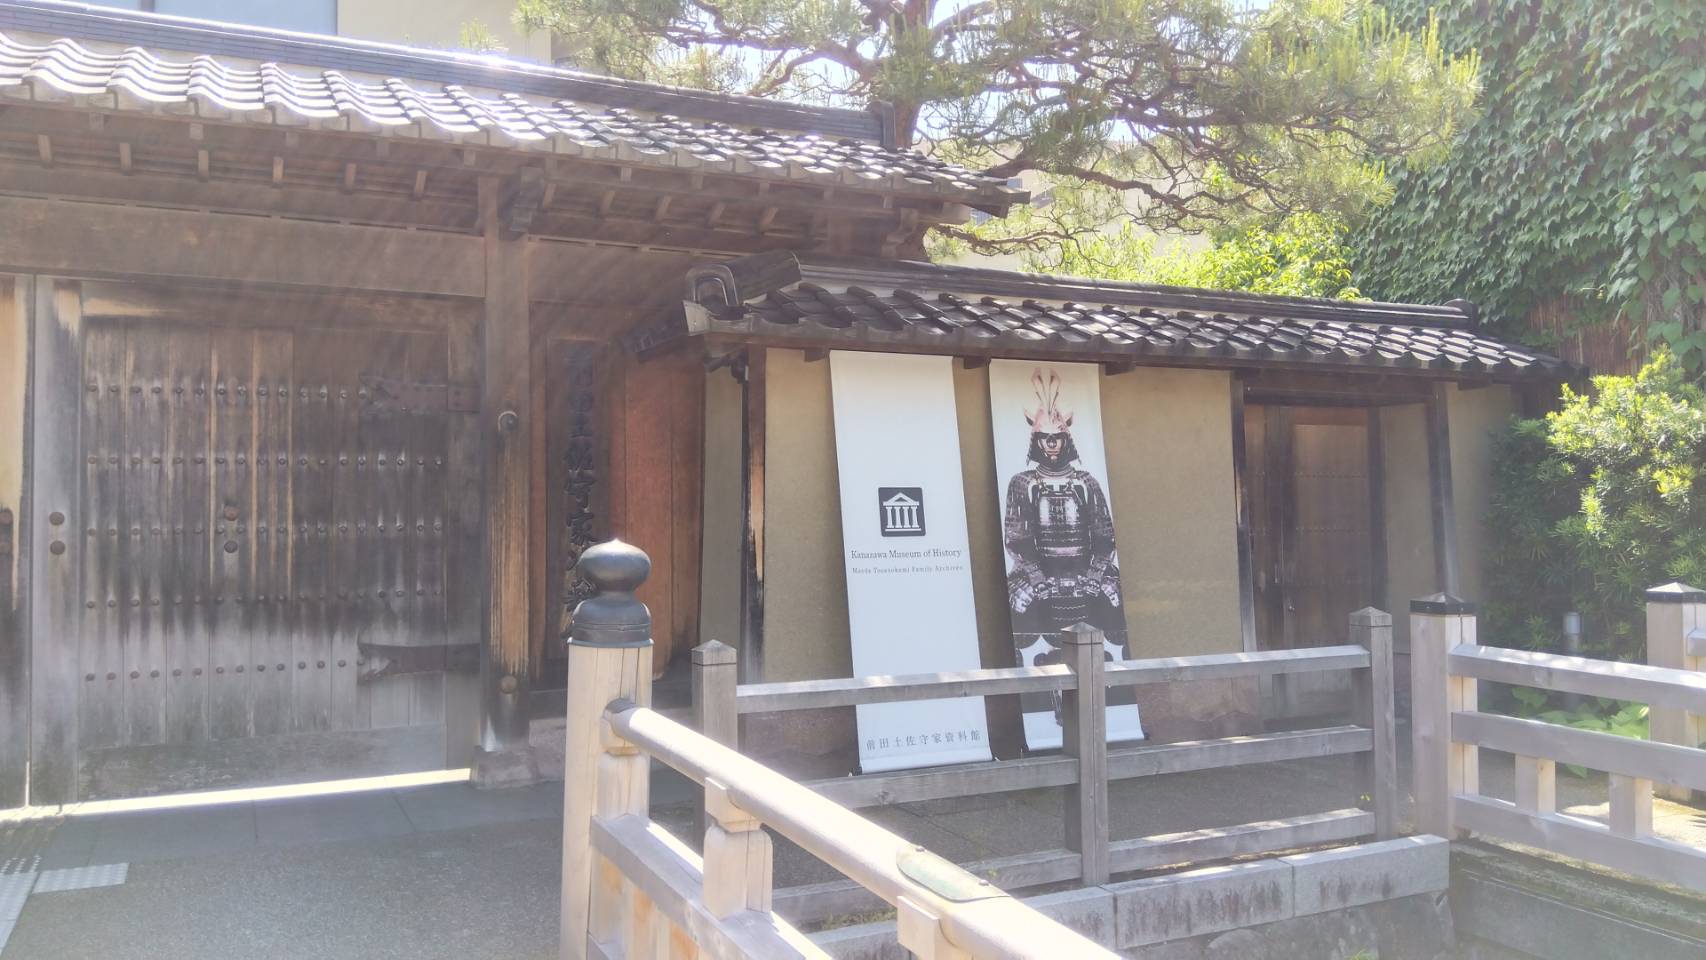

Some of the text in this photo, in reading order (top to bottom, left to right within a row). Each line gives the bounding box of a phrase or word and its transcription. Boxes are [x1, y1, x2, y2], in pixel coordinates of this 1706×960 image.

[851, 548, 962, 559] Kanazawa Museum of History
[866, 729, 981, 751] 前田土佐守家資料館
